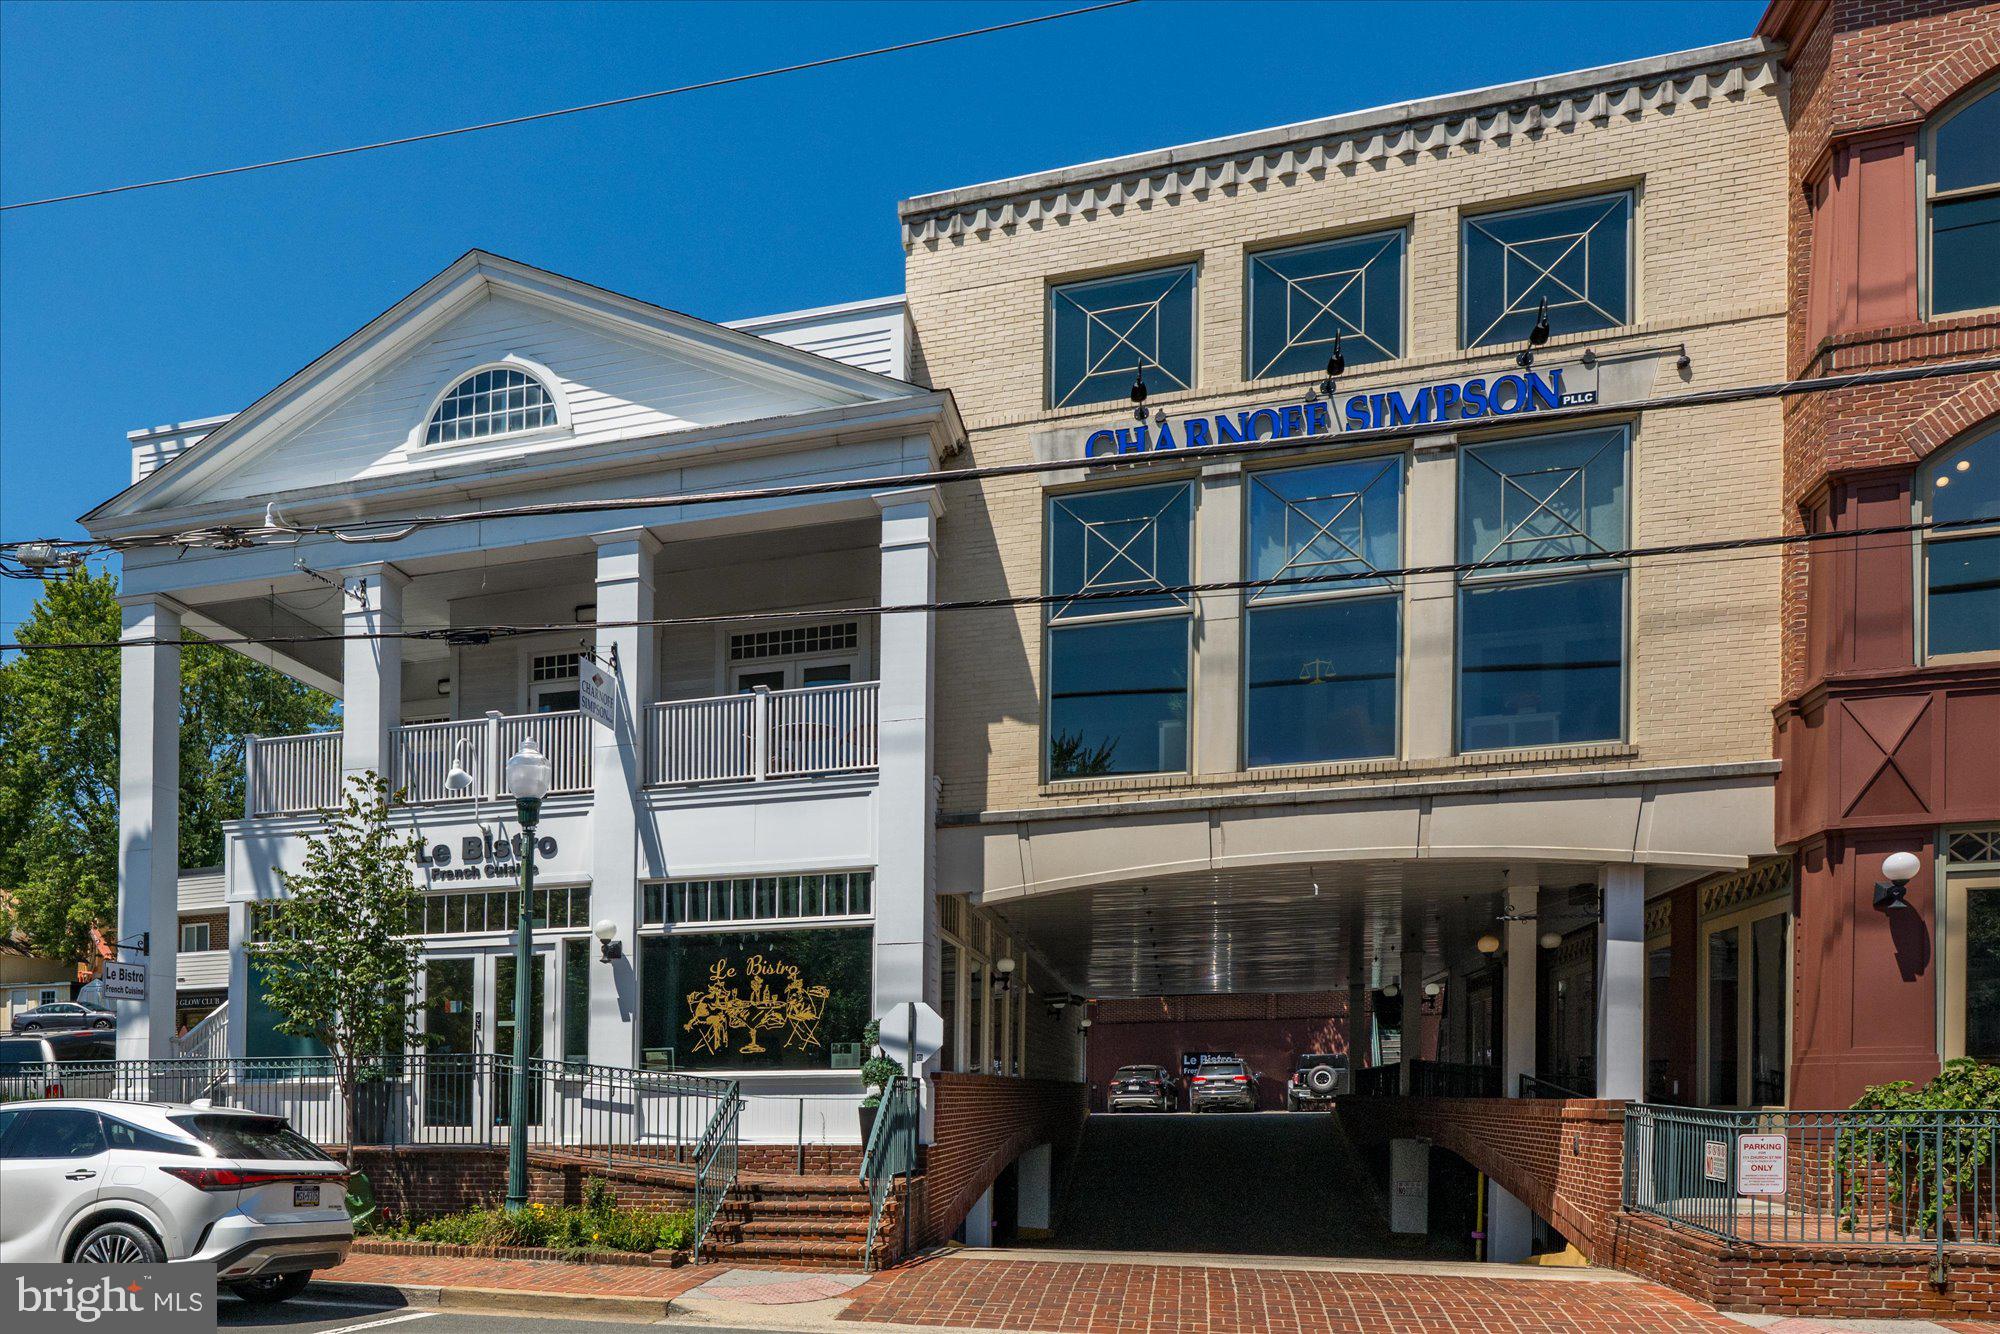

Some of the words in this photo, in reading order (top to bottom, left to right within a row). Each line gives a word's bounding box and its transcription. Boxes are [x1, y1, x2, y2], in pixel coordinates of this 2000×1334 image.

[1085, 402, 1328, 460] CHARNOFF
[1345, 369, 1563, 432] SIMPSON
[1562, 393, 1593, 405] PLLC
[581, 680, 614, 708] CHARNOFF
[581, 695, 610, 719] SIMPSON
[415, 840, 451, 864] Le
[462, 833, 557, 862] Bisto
[431, 867, 480, 882] French
[484, 862, 540, 880] Cuisie
[106, 967, 116, 980] Le
[119, 968, 144, 983] Bistro
[710, 957, 736, 980] Le
[746, 954, 800, 976] Bistro
[105, 984, 124, 994] French
[125, 986, 144, 996] Cuisine
[179, 998, 200, 1006] GLOW
[201, 997, 220, 1005] CLUB
[1183, 1054, 1197, 1065] Le
[1750, 1164, 1773, 1172] ONLY
